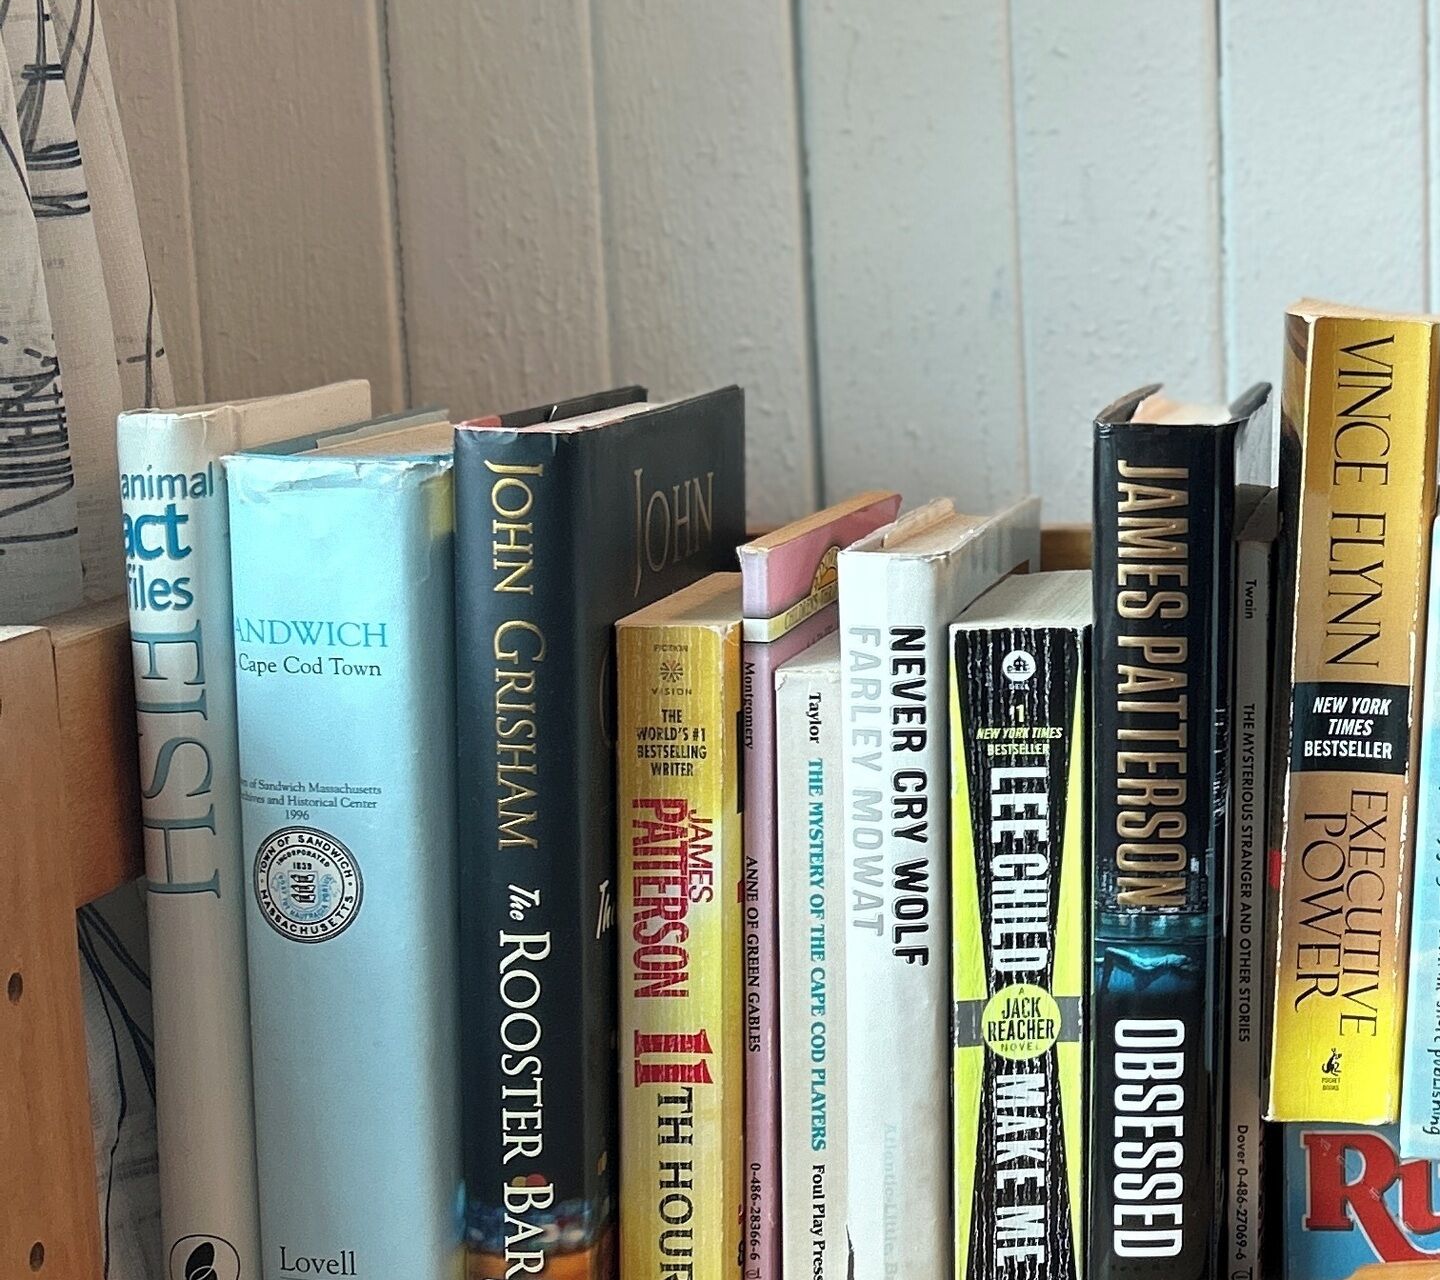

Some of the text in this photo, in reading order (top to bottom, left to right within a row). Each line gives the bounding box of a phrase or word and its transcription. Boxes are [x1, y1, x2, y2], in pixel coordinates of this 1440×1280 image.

[122, 462, 213, 500] animal
[1326, 335, 1395, 668] VINCE FLYNN
[239, 653, 382, 676] Cape Cod Town
[484, 459, 547, 850] JOHN GRISHAM
[1116, 460, 1189, 906] JAMES PATTERSON
[1312, 696, 1392, 716] NEW YORK
[636, 728, 705, 741] WORLD'S #1
[662, 709, 682, 723] THE
[806, 692, 822, 744] Taylor
[1328, 717, 1374, 737] TIMES
[133, 621, 221, 899] FISH
[638, 745, 707, 759] BESTSELLING
[651, 763, 693, 776] WRITER
[987, 744, 1050, 757] BESTSELLER
[1304, 739, 1393, 760] BESTSELLER
[258, 781, 381, 794] Sandwich Massachusetts
[287, 796, 378, 809] Historical Center
[849, 627, 884, 936] FARLEY MOWAT
[888, 626, 930, 966] NEVER CRY WOLF
[285, 810, 309, 820] 1996
[688, 808, 713, 904] JAMES
[991, 767, 1050, 972] LEE CHILD
[632, 798, 691, 999] PATTERSON
[1294, 812, 1348, 1013] POWER
[1340, 789, 1388, 1036] EXECUTIVE
[746, 856, 761, 1053] ANNE OF GREEN GABLES
[808, 758, 827, 1151] THE MYSTERY OF THE CAPE COD PLAYERS
[988, 1018, 1055, 1042] REACHER
[1001, 996, 1041, 1019] JACK
[500, 884, 554, 1278] The ROOSTER BAR
[1113, 1018, 1185, 1258] OBSESSED
[996, 1073, 1045, 1267] MAKE ME
[280, 1247, 358, 1276] Lovell
